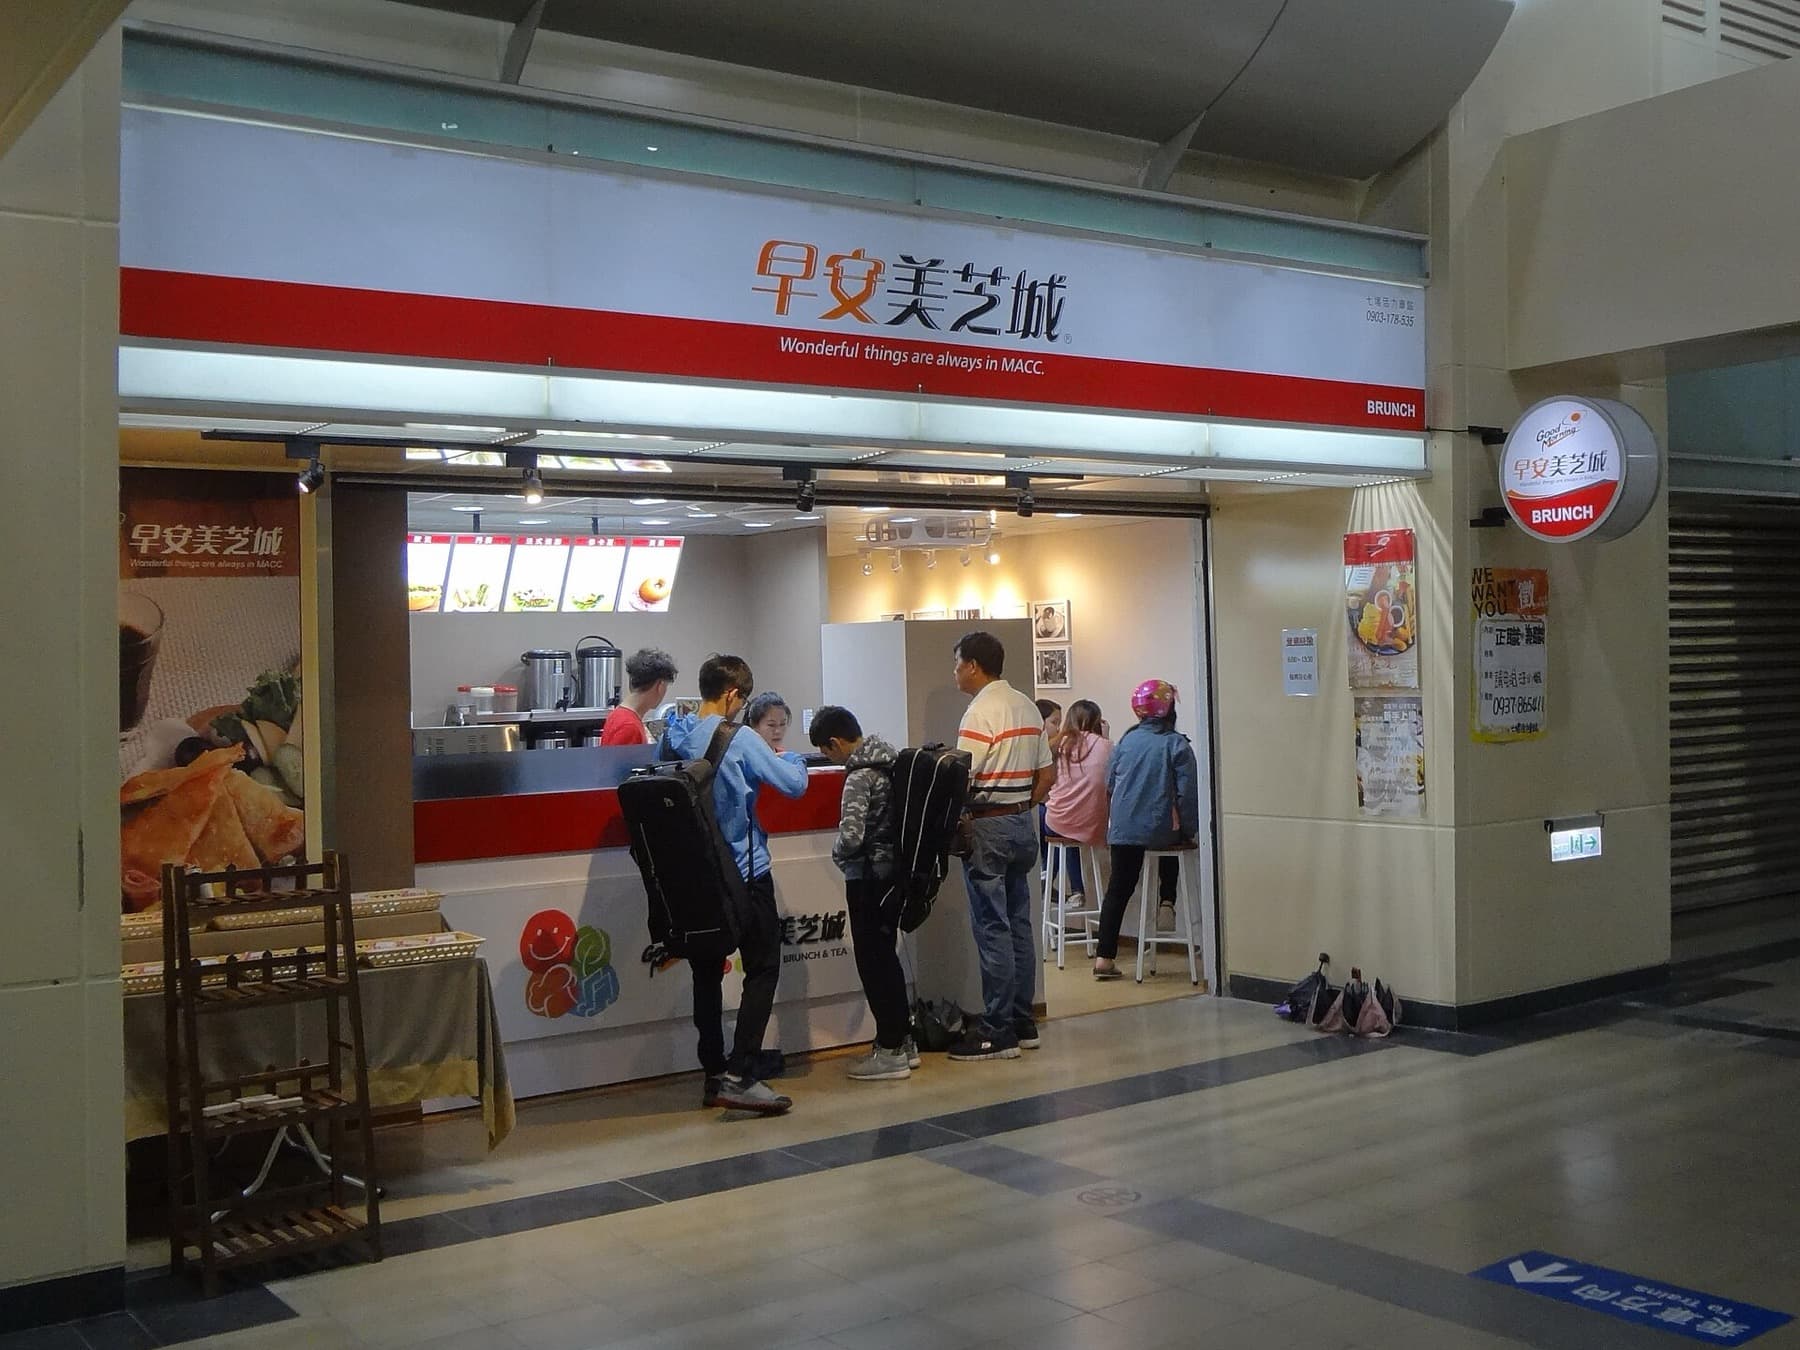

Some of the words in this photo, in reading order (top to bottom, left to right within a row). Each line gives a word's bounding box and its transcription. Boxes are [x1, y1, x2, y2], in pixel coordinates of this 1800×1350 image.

[752, 239, 1067, 342] 早安美芝城
[780, 336, 859, 358] Wonderful
[864, 344, 909, 366] things
[911, 352, 933, 364] are
[936, 351, 982, 372] always
[985, 355, 998, 370] in
[1001, 357, 1045, 375] MACC.
[1367, 400, 1416, 418] BRUNCH
[1536, 424, 1561, 442] Good
[1542, 427, 1577, 452] Morning
[1513, 450, 1607, 480] 早安美芝城
[1531, 504, 1593, 524] BRUNCH
[129, 524, 283, 556] 早安美芝城
[1472, 580, 1516, 601] WANT
[1474, 599, 1507, 618] YOU
[783, 951, 821, 963] BRUNCH
[822, 949, 829, 958] &
[831, 947, 848, 957] TEA
[1632, 1284, 1701, 1308] Trains
